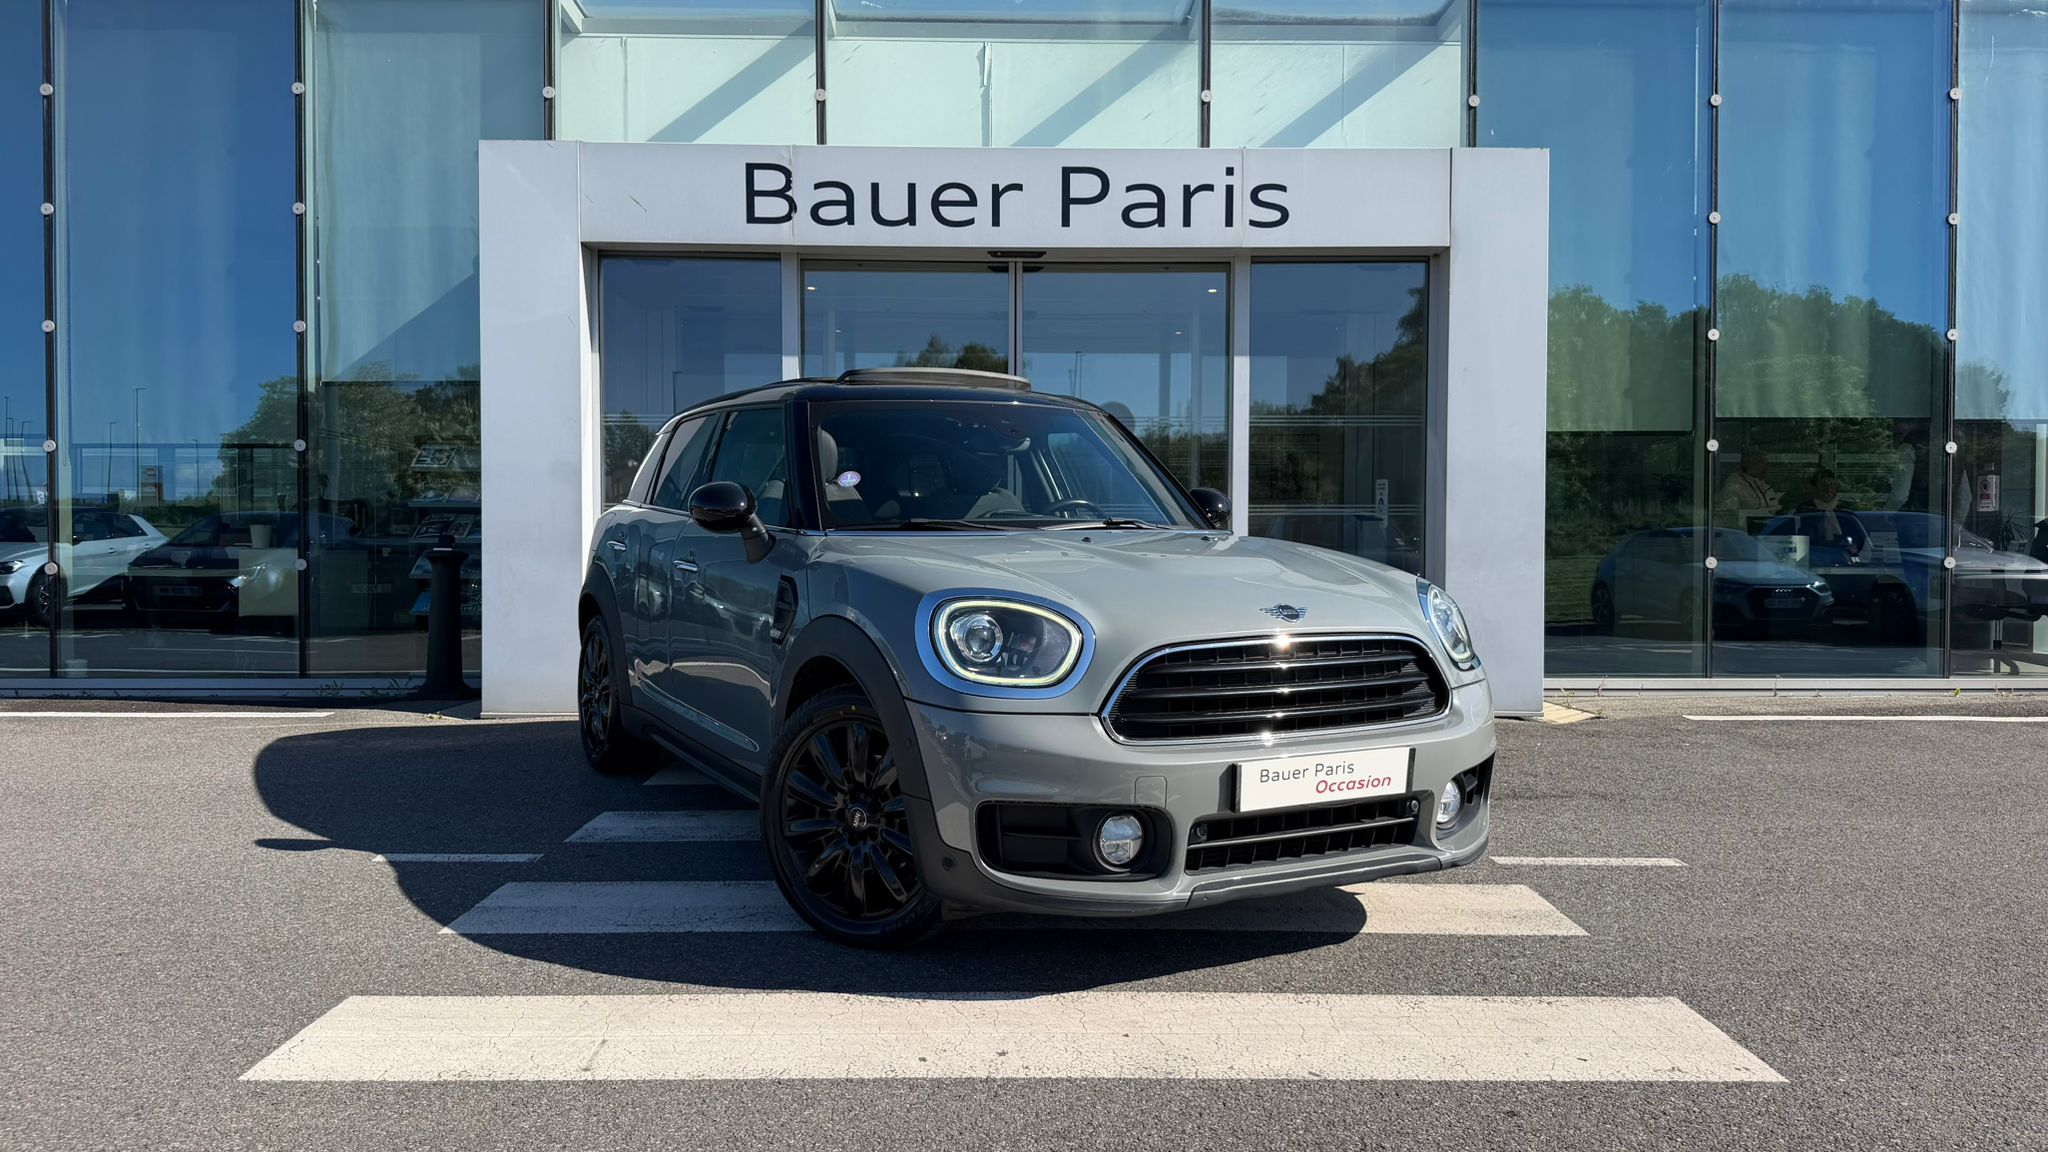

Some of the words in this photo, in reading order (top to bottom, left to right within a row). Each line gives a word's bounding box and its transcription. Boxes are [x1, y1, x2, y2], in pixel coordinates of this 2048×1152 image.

[745, 162, 1024, 228] Bauer
[1061, 166, 1290, 229] Paris
[1260, 767, 1309, 783] Bauer
[1314, 761, 1355, 777] Paris
[1315, 775, 1392, 794] Occasion
